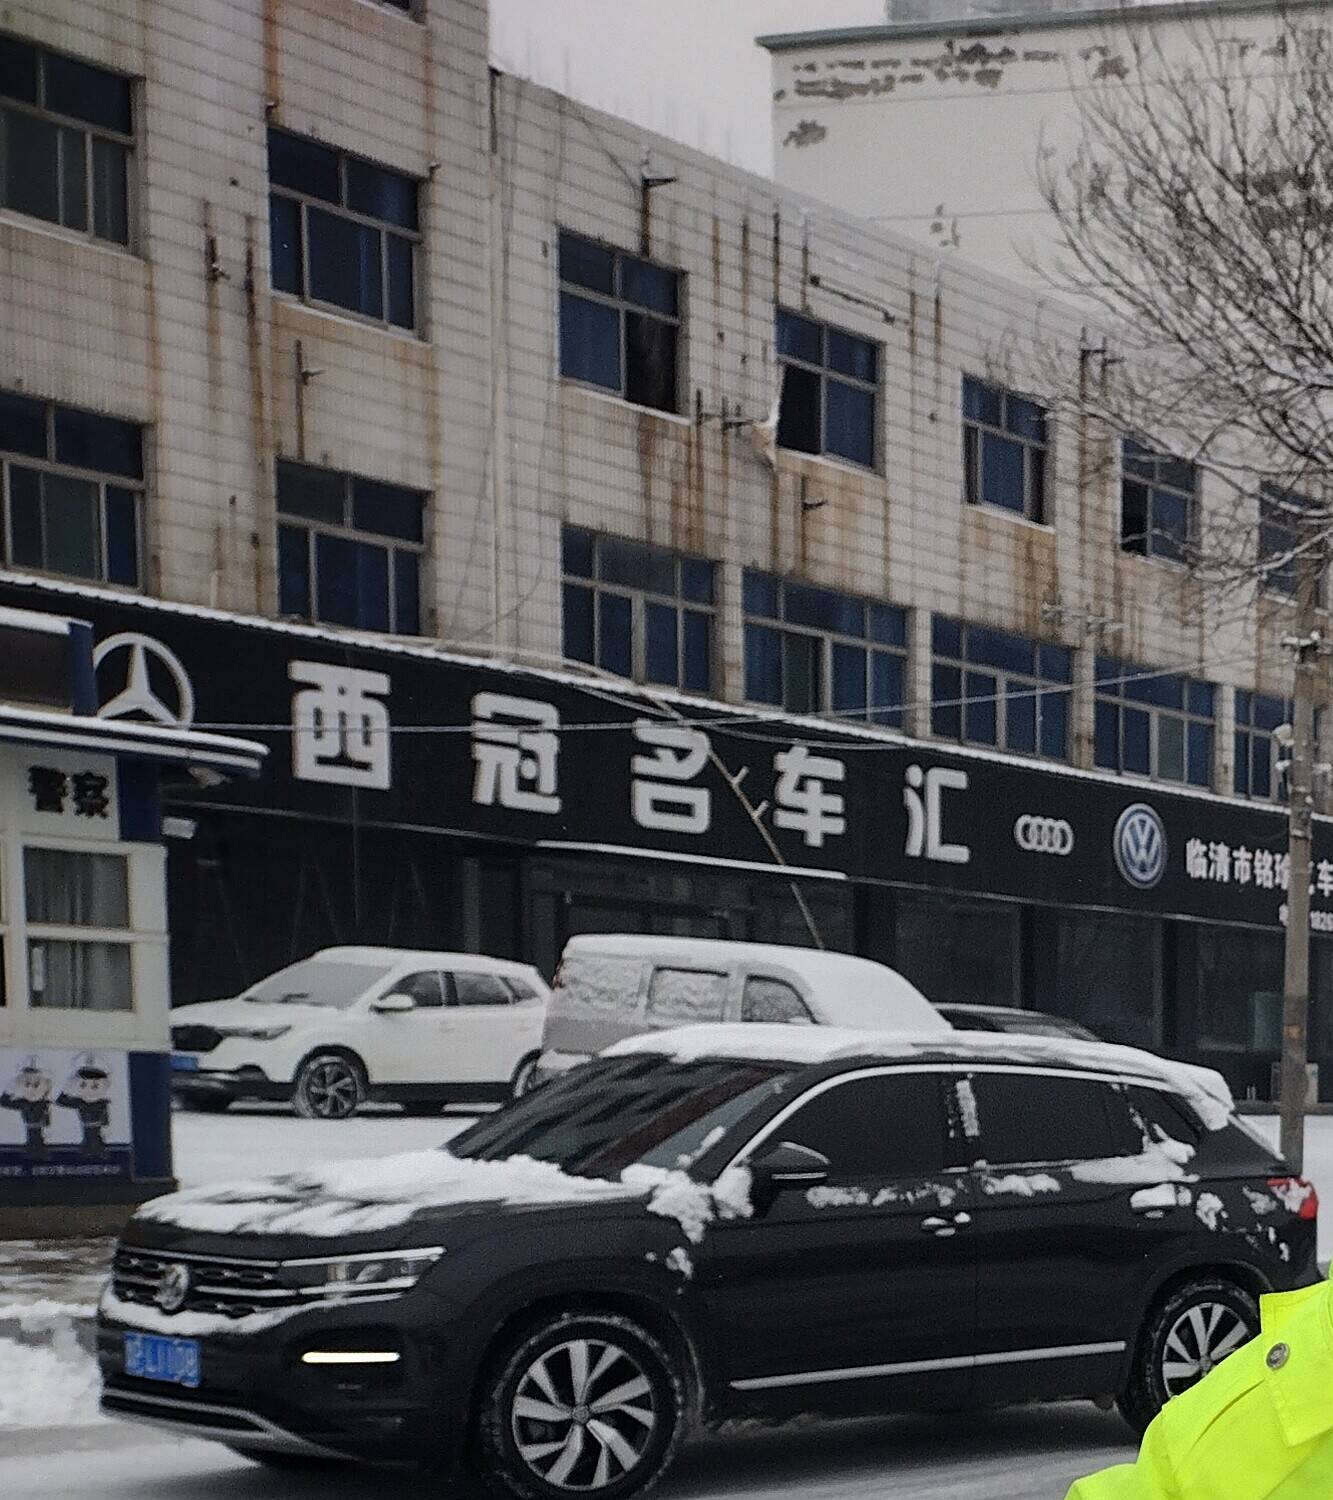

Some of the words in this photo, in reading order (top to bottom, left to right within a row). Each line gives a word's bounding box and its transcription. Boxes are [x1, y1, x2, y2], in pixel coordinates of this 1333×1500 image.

[28, 765, 109, 819] 警察
[288, 660, 970, 863] 西冠名车汇
